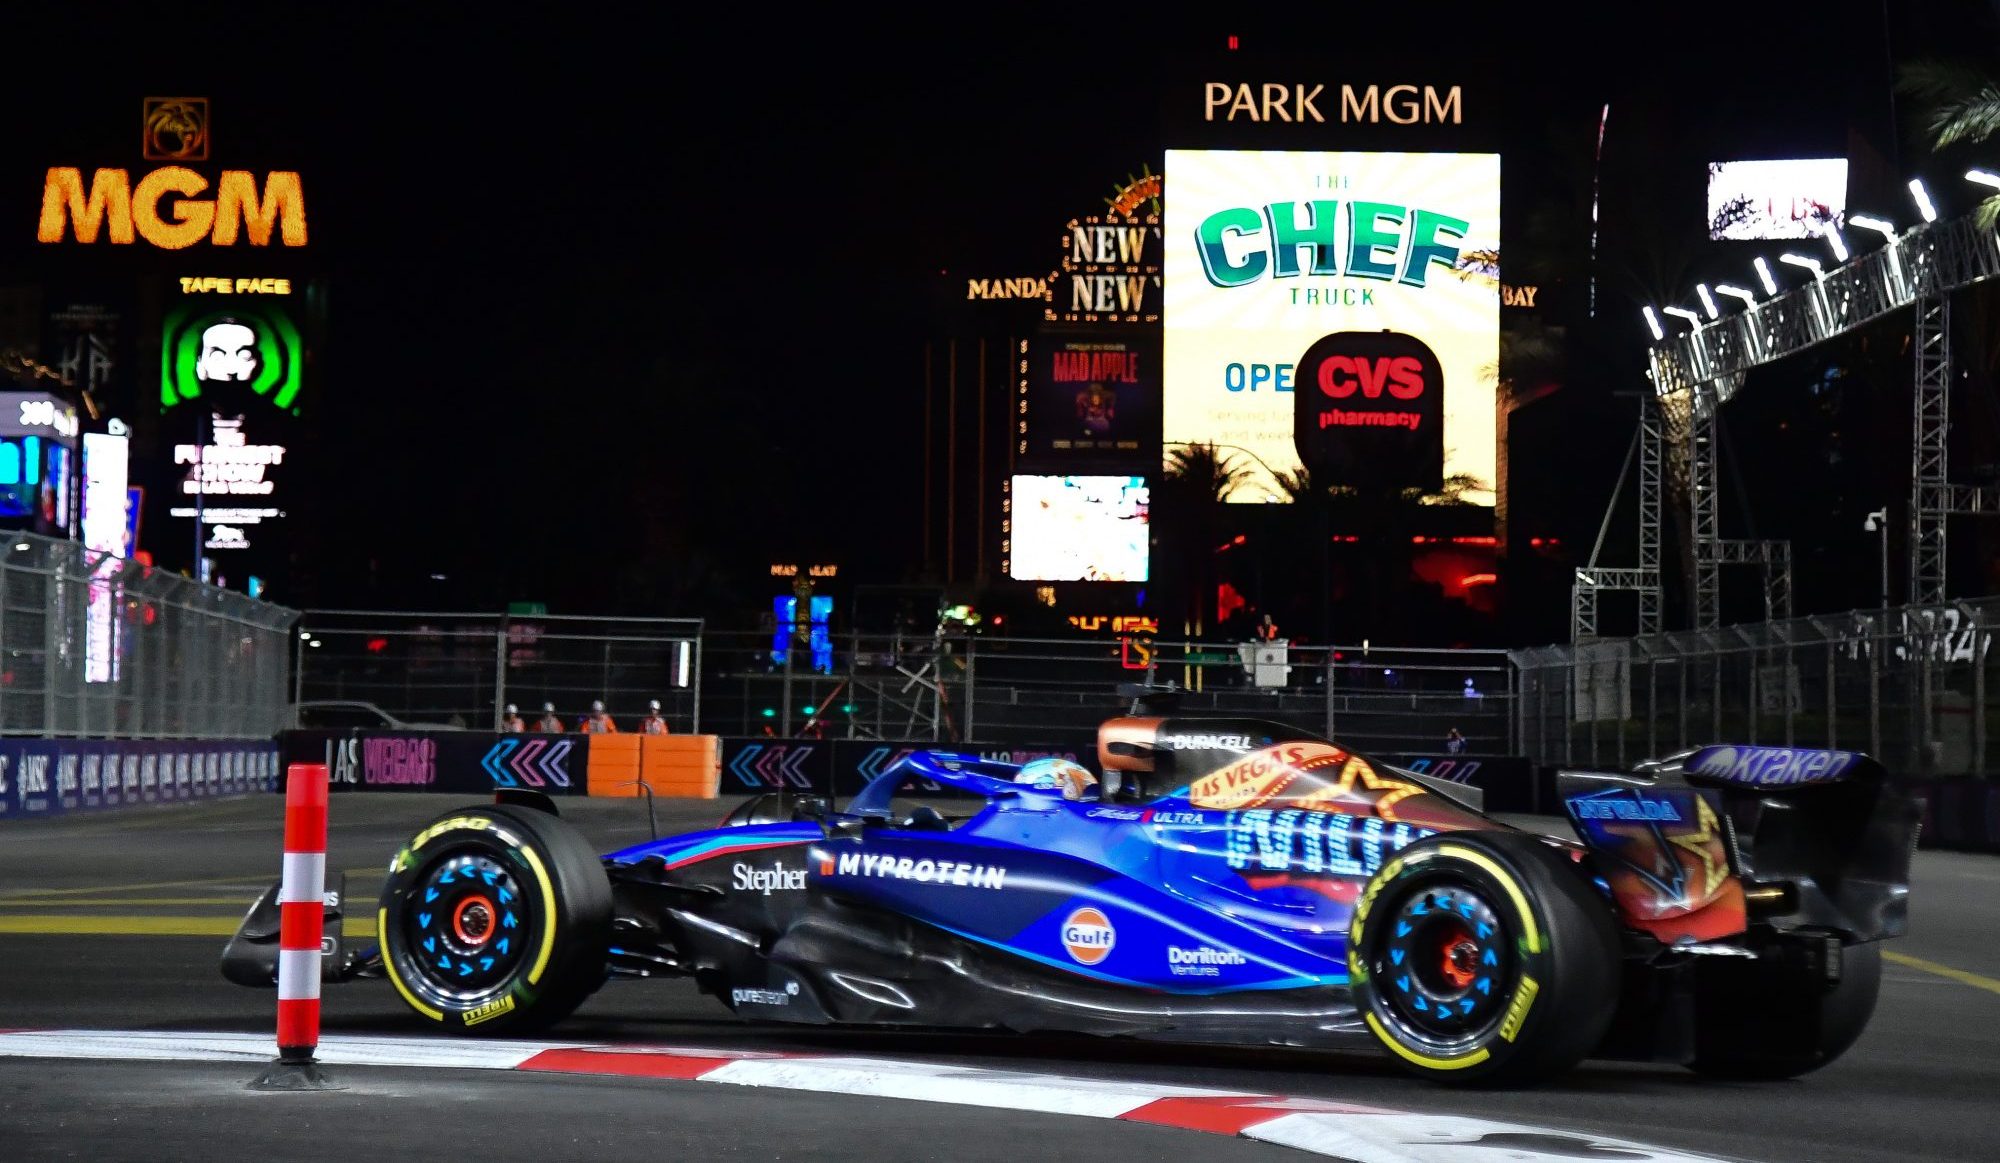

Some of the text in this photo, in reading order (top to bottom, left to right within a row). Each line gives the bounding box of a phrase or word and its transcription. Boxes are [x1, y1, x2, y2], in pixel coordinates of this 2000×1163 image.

[1205, 82, 1462, 124] PARK MGM
[37, 166, 308, 250] MGM
[1072, 226, 1147, 263] NEW
[1194, 200, 1470, 289] CHEF
[180, 277, 291, 294] TAPE FACE
[1072, 275, 1147, 312] NEW
[1289, 287, 1375, 306] TRUCK
[1502, 285, 1538, 307] BAY
[1052, 351, 1139, 383] MAD APPLE
[1319, 356, 1424, 398] CVS
[1319, 410, 1421, 429] pharmacy
[326, 738, 358, 783] LAS
[1174, 735, 1251, 749] DURACELL
[1225, 747, 1305, 788] VEGAS
[1153, 812, 1204, 825] ULTRA
[839, 853, 1006, 891] MYPROTEIN
[1065, 926, 1111, 945] Gulf
